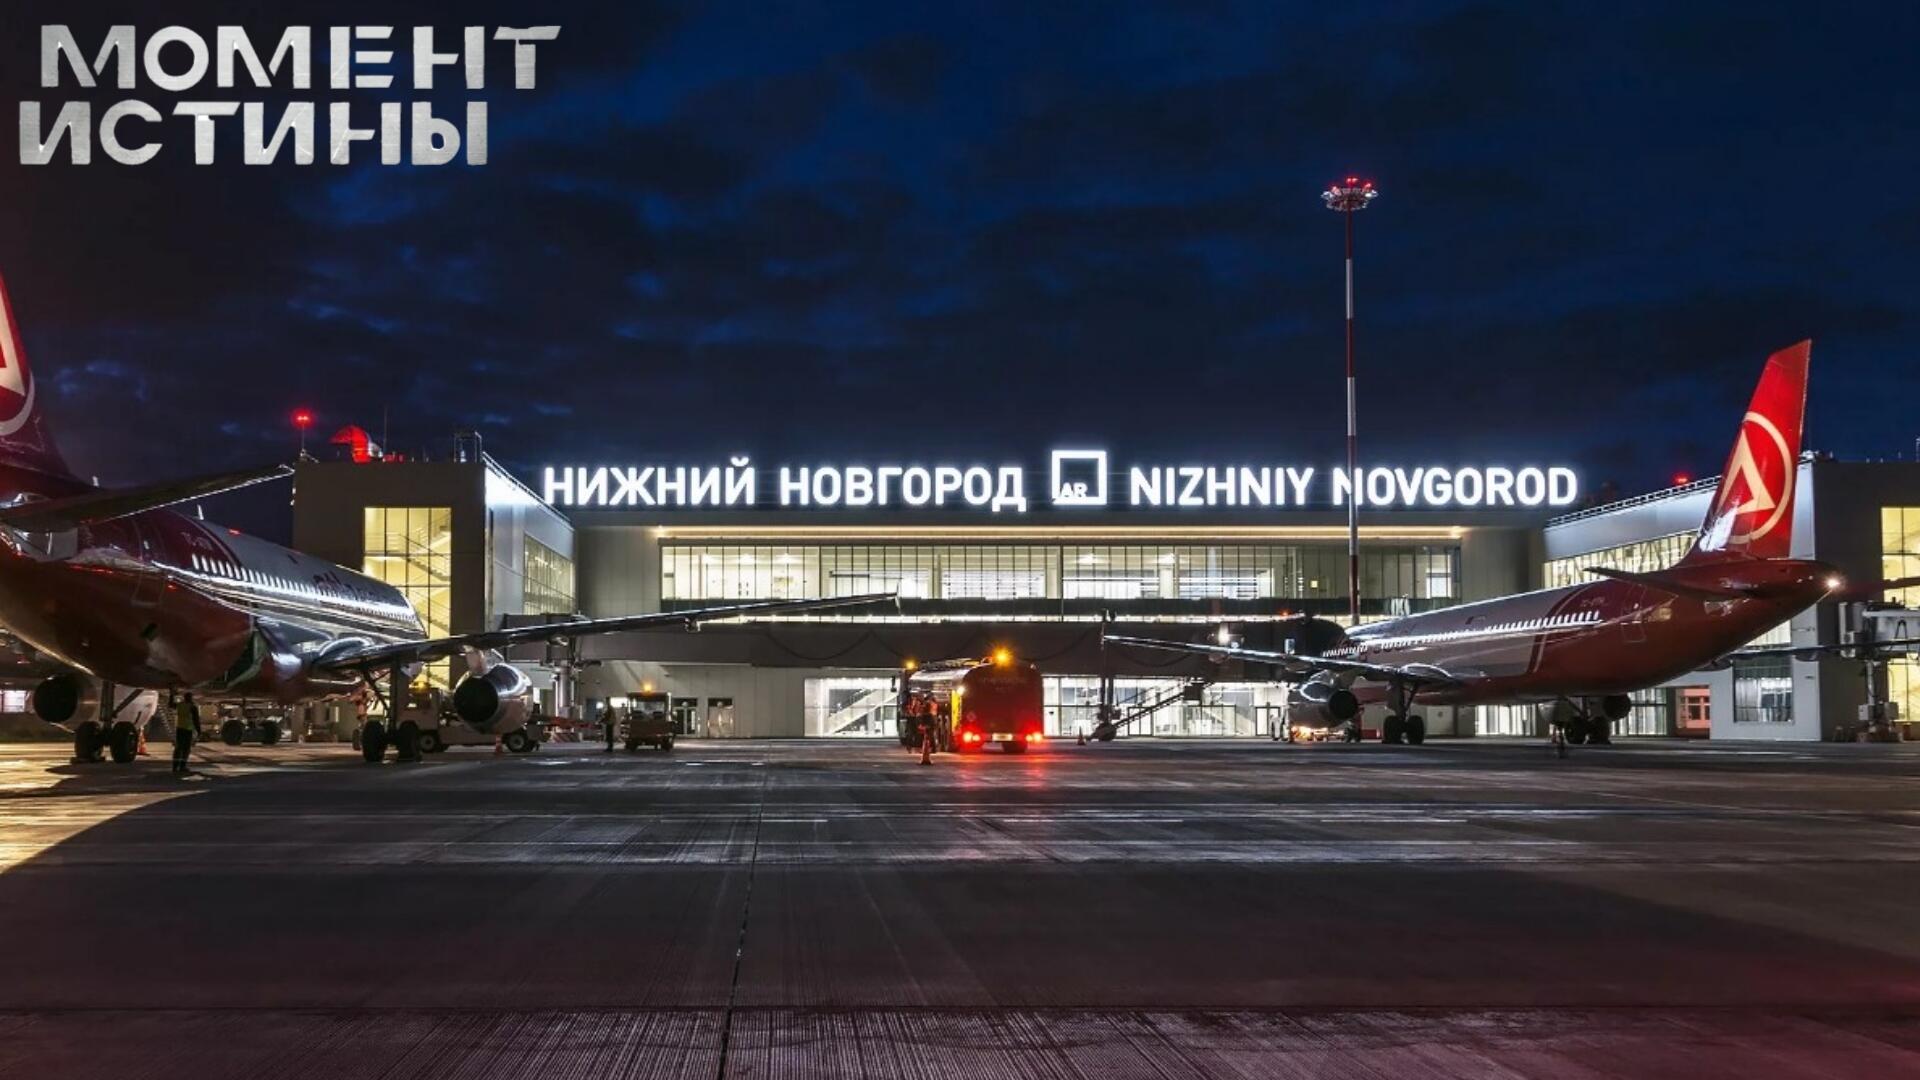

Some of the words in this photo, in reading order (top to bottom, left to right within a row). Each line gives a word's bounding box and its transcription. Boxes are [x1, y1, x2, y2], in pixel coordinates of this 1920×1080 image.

[544, 457, 755, 506] НИЖНИЙ
[780, 466, 1026, 512] НОВГОРОД
[1060, 482, 1088, 498] AR
[1130, 467, 1314, 506] NIZHNIY
[1333, 467, 1578, 506] NOVGOROD
